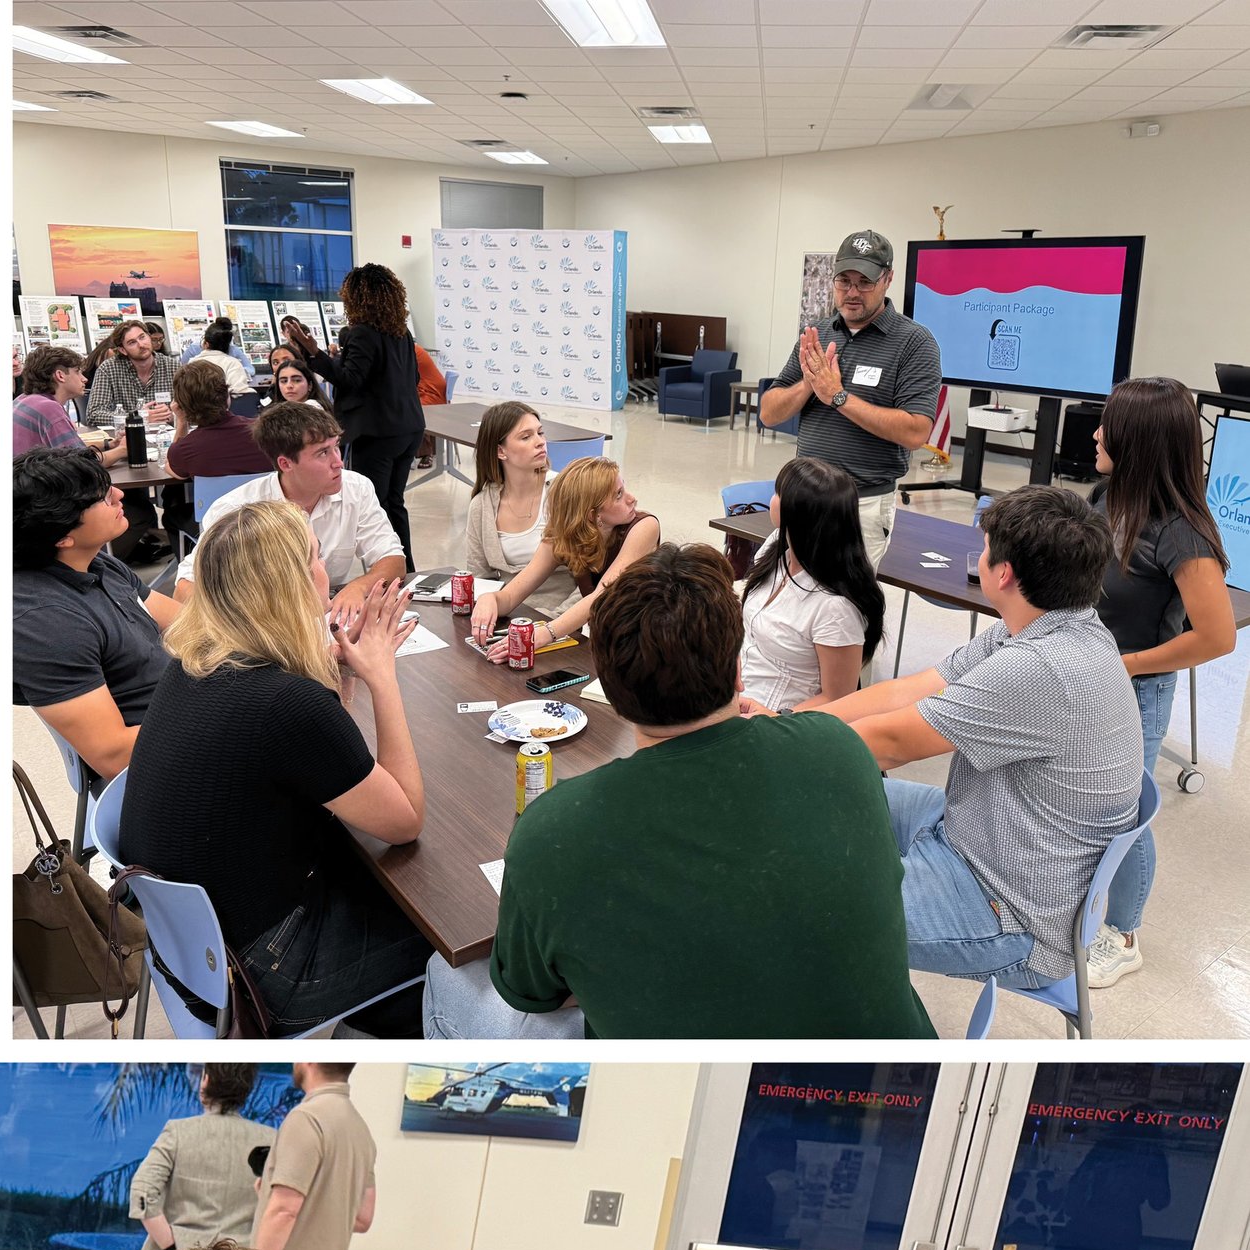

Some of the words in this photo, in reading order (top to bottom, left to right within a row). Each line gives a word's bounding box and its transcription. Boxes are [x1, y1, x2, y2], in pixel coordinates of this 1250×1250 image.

[963, 302, 1010, 314] Participant
[1013, 303, 1055, 316] Package
[998, 325, 1013, 333] SCAN
[758, 1084, 843, 1101] EMERGENCY
[848, 1091, 880, 1104] EXIT
[883, 1094, 923, 1108] ONLY
[1028, 1103, 1130, 1122] EMERGENCY
[1135, 1111, 1173, 1126] EXIT
[1178, 1115, 1224, 1130] ONLY
